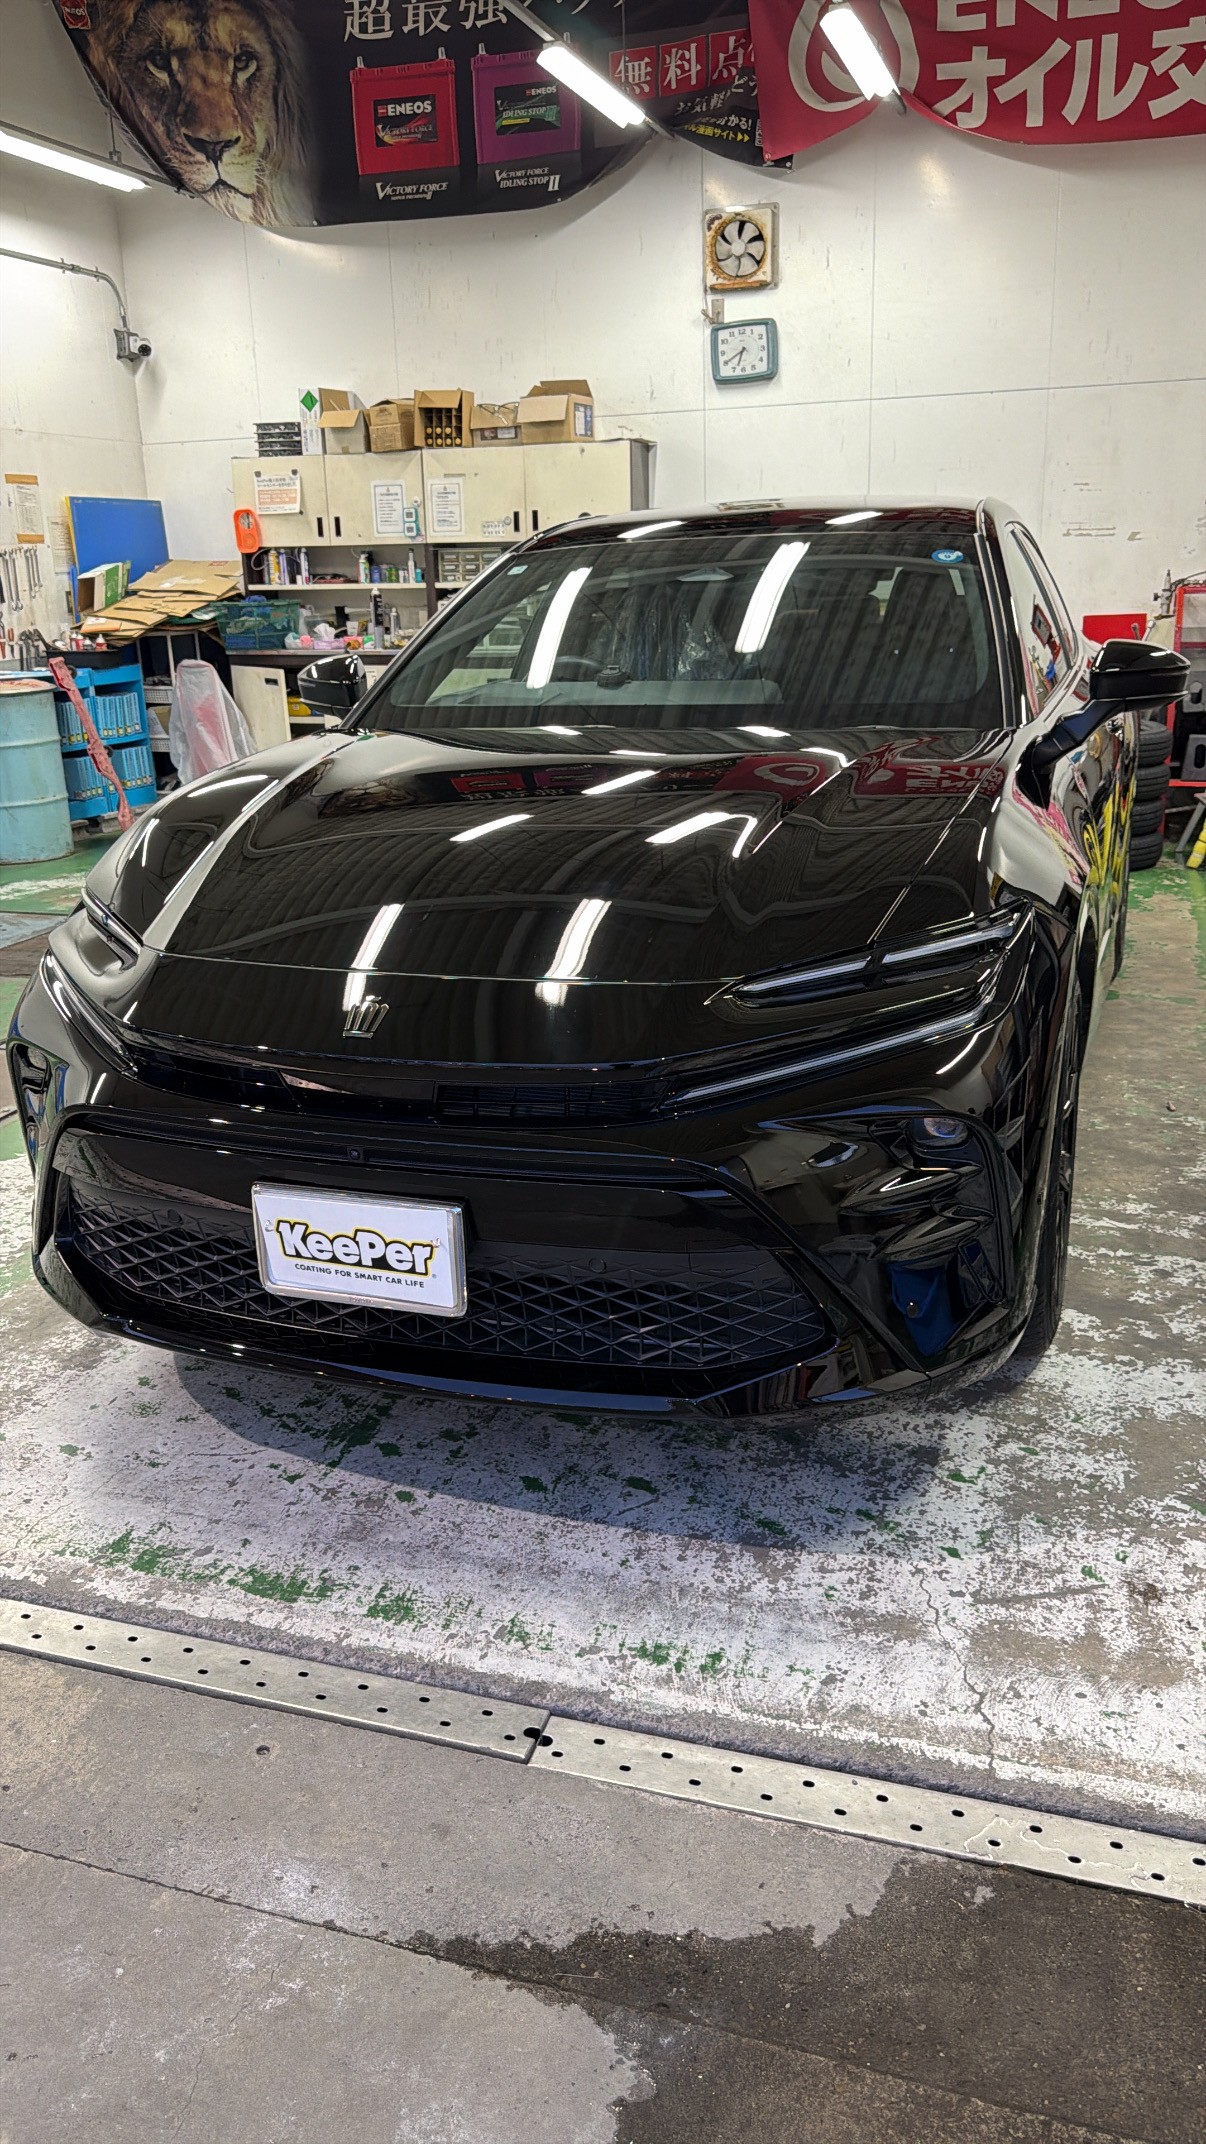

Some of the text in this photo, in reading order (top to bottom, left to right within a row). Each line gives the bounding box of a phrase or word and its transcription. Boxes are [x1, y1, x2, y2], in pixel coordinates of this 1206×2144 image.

[615, 36, 755, 95] 無料点
[530, 86, 557, 96] ENEOS
[387, 100, 432, 117] ENEOS
[494, 167, 549, 183] VICTORY FORCE
[500, 178, 528, 189] IDLING
[528, 176, 550, 186] STOP
[375, 182, 449, 200] VICTORY FORCE
[275, 1218, 435, 1277] KeePer
[294, 1263, 425, 1289] COATING FOR SMART CAR LIFE
